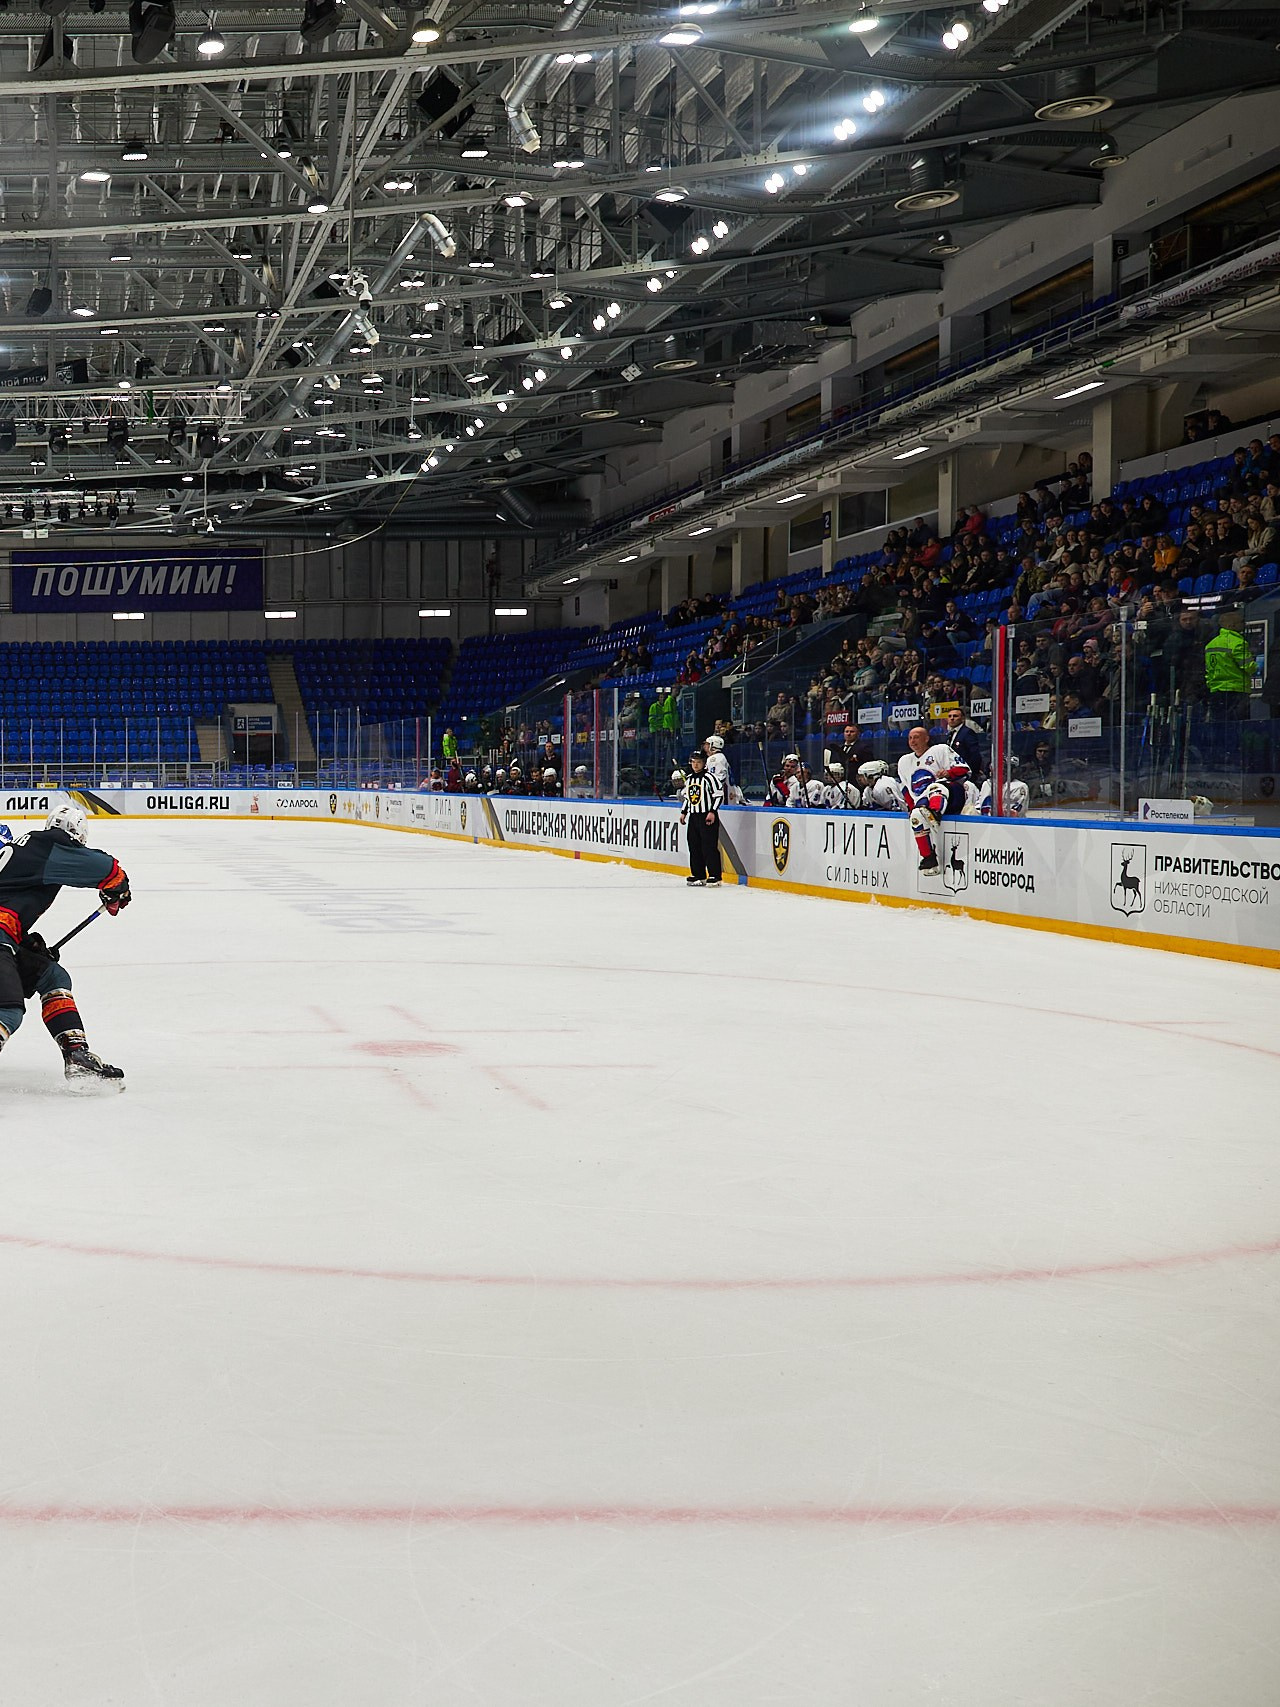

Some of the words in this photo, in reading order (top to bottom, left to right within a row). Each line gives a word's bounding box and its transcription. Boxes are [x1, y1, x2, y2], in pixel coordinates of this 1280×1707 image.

[824, 514, 830, 528] 2
[31, 564, 237, 597] ПОШУМИМ!
[827, 712, 849, 724] FONBET
[972, 701, 992, 714] KHL.
[6, 796, 48, 810] ЛИГА
[146, 795, 230, 810] OHLIGA.RU
[1150, 810, 1189, 820] Ростелеком
[505, 809, 567, 839] ОФИЦЕРСКАЯ
[570, 808, 639, 848] ХОККЕЙНАЯ
[644, 820, 679, 852] ЛИГА
[823, 821, 891, 859] ЛИГА
[974, 846, 1024, 867] НИЖНИЙ
[826, 865, 889, 888] СИЛЬНЫХ
[1154, 855, 1280, 881] ПРАВИТЕЛЬСТВО
[974, 869, 1035, 893] НОВГОРОД
[1154, 880, 1269, 905] НИЖЕГОРОДСКОЙ
[1154, 898, 1210, 918] ОБЛАСТИ
